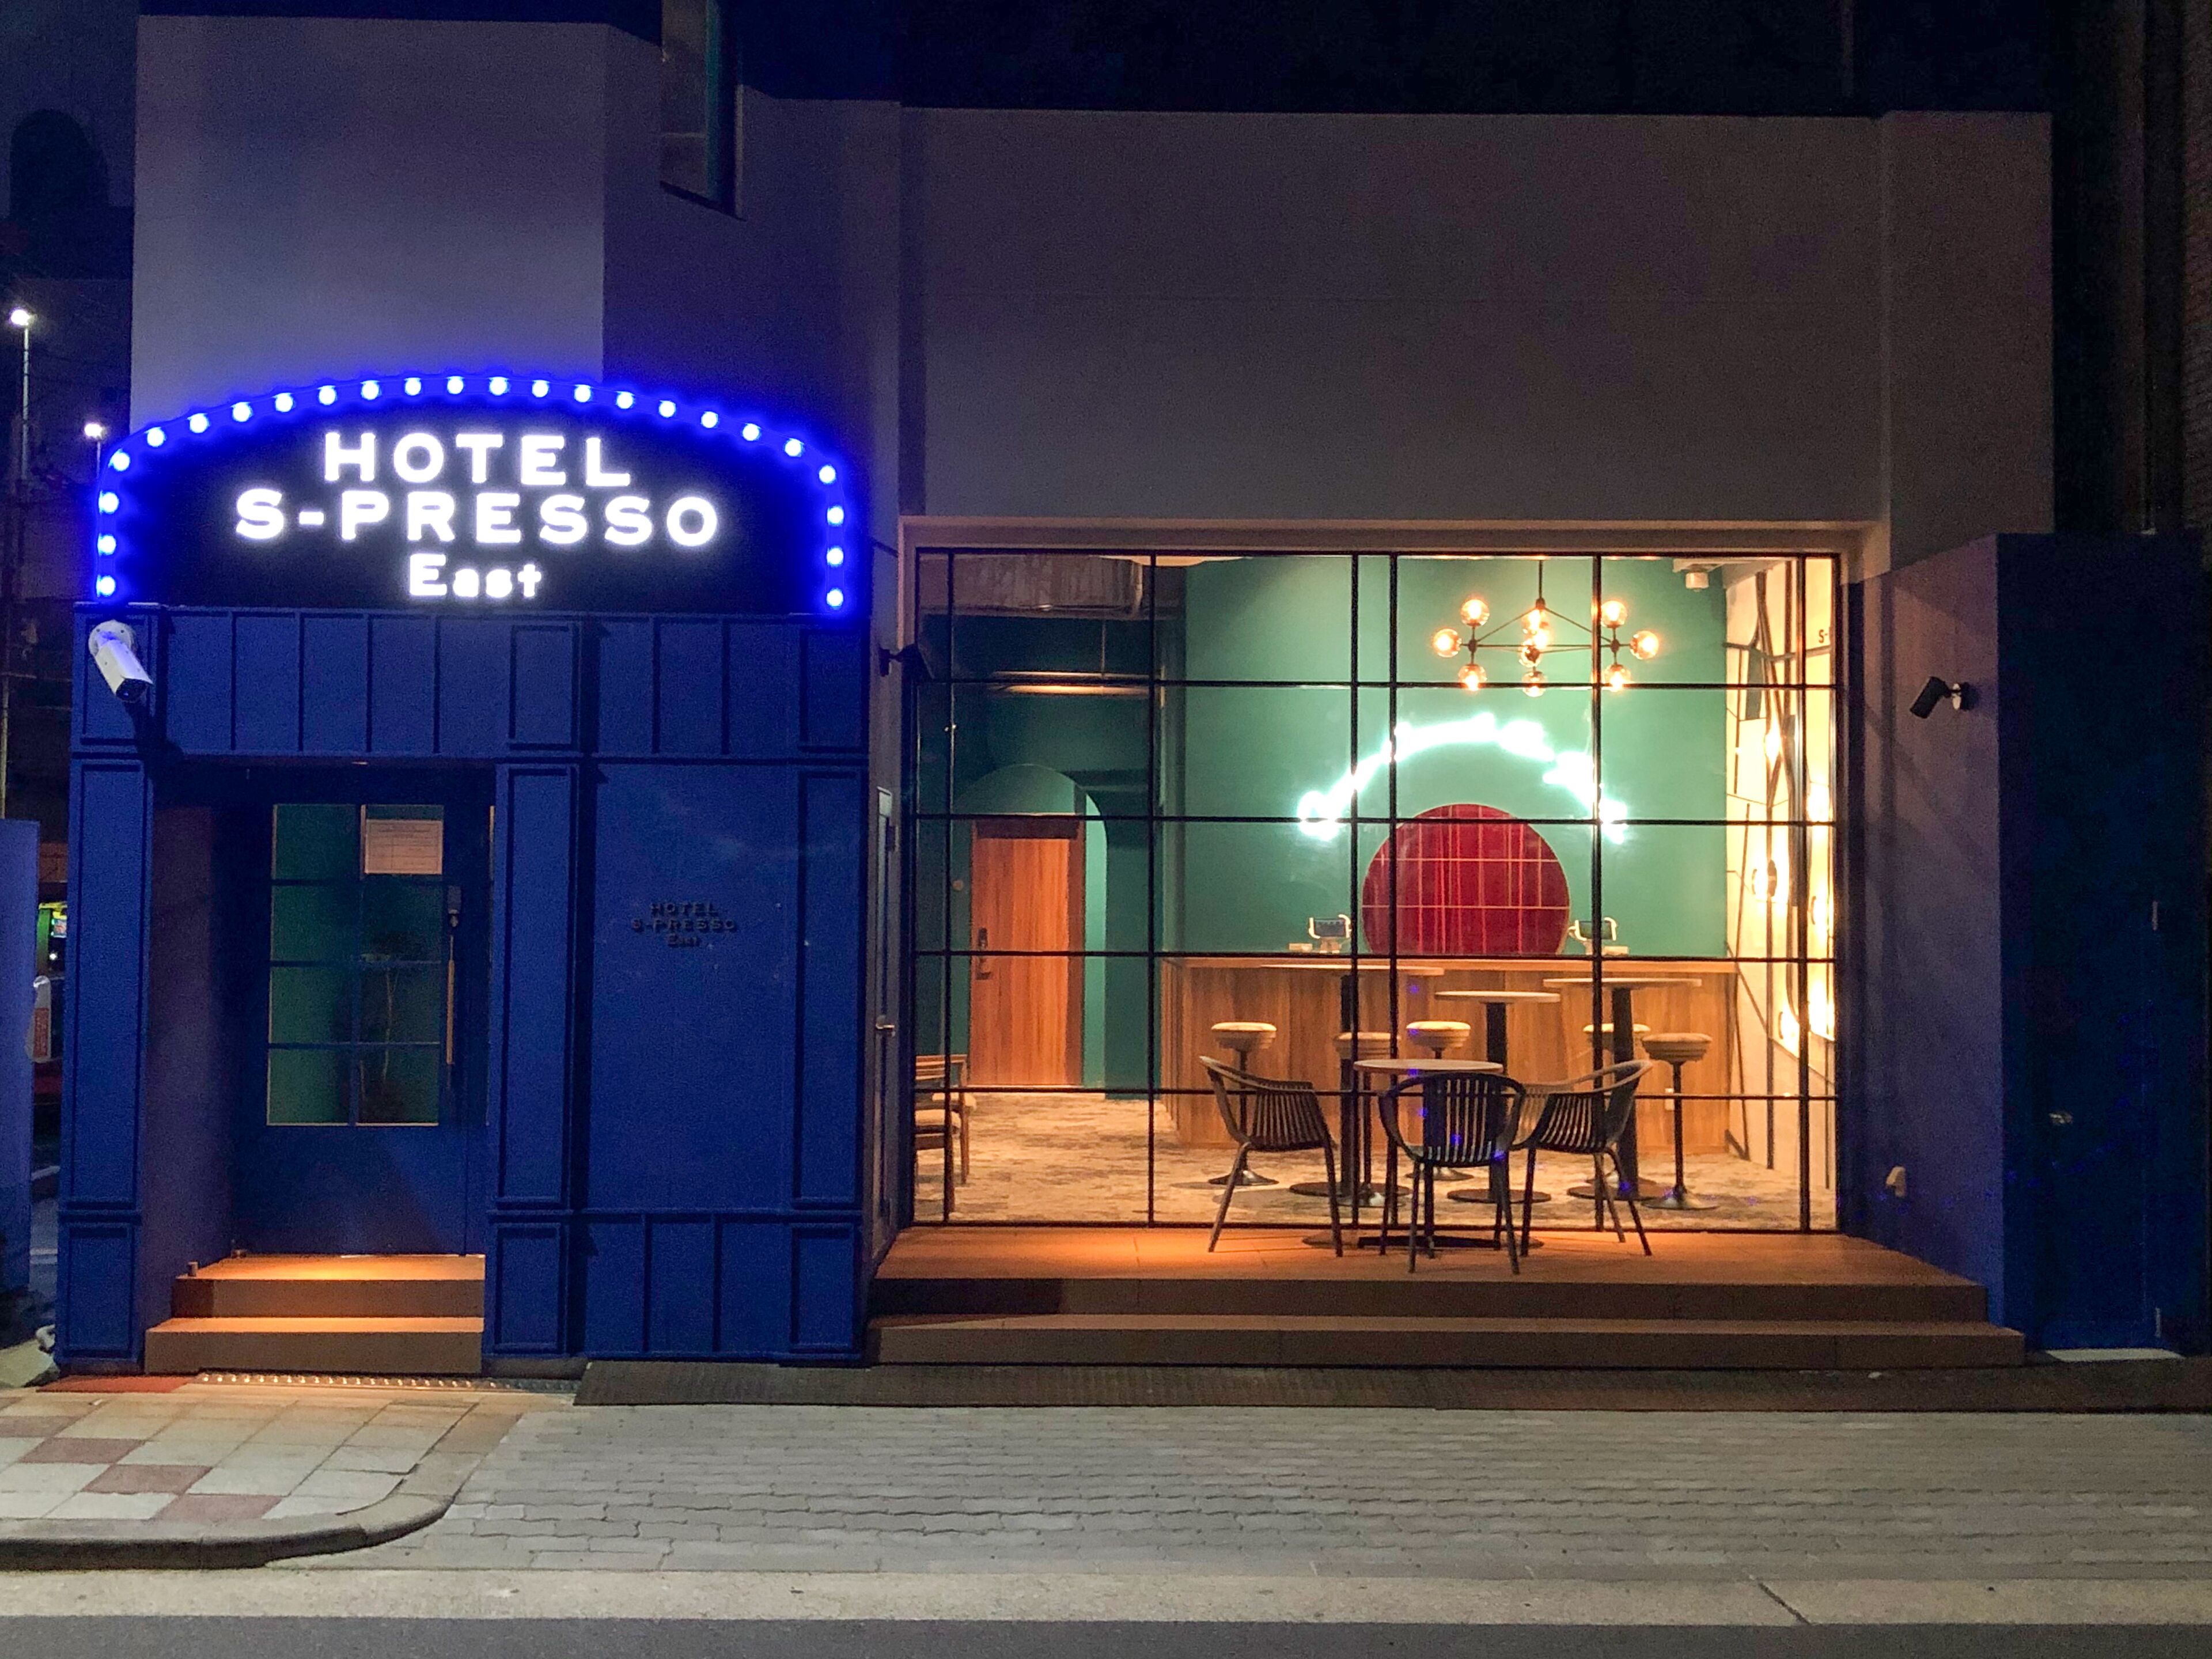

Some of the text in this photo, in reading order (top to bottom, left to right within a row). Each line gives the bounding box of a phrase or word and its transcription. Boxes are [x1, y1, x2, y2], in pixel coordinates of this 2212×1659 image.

[323, 431, 631, 488] HOTEL
[234, 487, 719, 547] S-PRESSO
[408, 552, 543, 599] East
[649, 902, 718, 915] HOTEL
